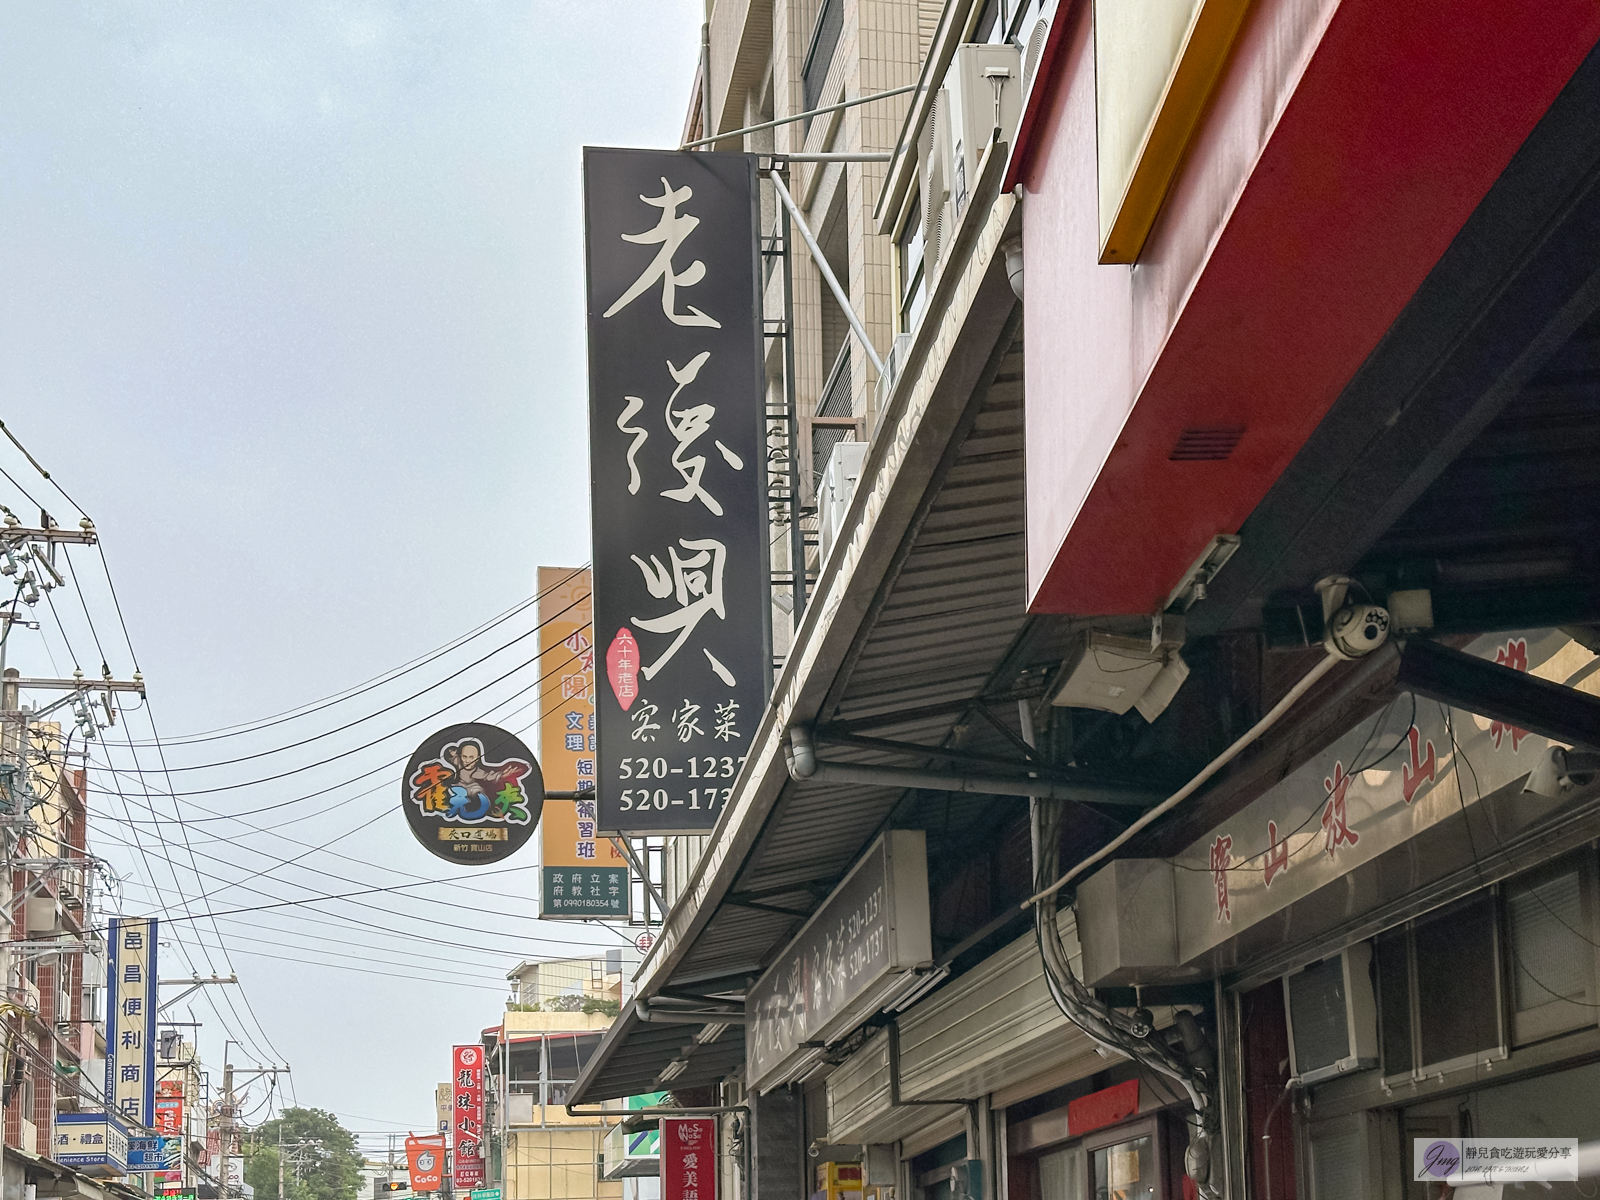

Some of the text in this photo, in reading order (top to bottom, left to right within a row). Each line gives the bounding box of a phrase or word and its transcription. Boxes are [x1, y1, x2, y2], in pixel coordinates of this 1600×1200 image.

[617, 634, 635, 698] 六十年老店
[565, 711, 584, 751] 文理
[630, 699, 741, 743] 客家菜
[552, 873, 619, 884] 政府立案
[552, 886, 619, 896] 府教社字
[121, 931, 144, 1117] 邑昌便利商店
[106, 1053, 115, 1097] Convenience
[456, 1068, 476, 1158] 龍珠小館
[86, 1155, 105, 1163] Store
[414, 1175, 438, 1184] CoCo
